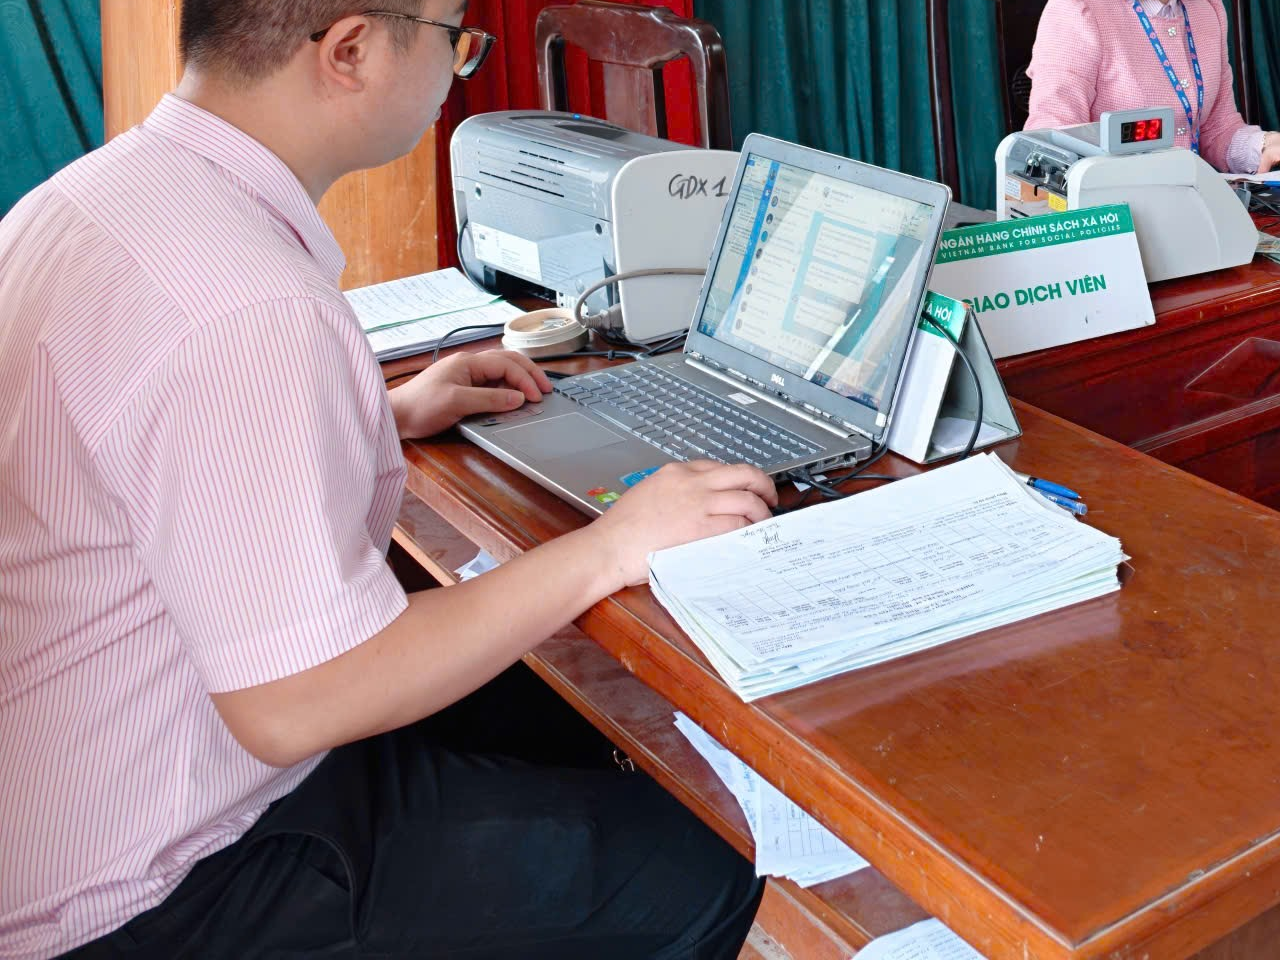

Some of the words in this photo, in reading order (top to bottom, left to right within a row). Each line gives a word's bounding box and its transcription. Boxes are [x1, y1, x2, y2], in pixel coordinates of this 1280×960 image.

[942, 246, 985, 259] VIETNAM
[989, 242, 1014, 252] BANK
[1019, 238, 1036, 247] FOR
[1041, 232, 1076, 243] SOCIAL
[1080, 224, 1121, 237] POLICIES
[976, 227, 1010, 245] HÀNG
[1012, 222, 1047, 240] CHÍNH
[1049, 217, 1080, 234] SÁCH
[1082, 214, 1098, 228] XÃ
[1100, 211, 1119, 225] HỘI
[1014, 283, 1062, 306] DỊCH
[1065, 274, 1107, 296] VIÊN
